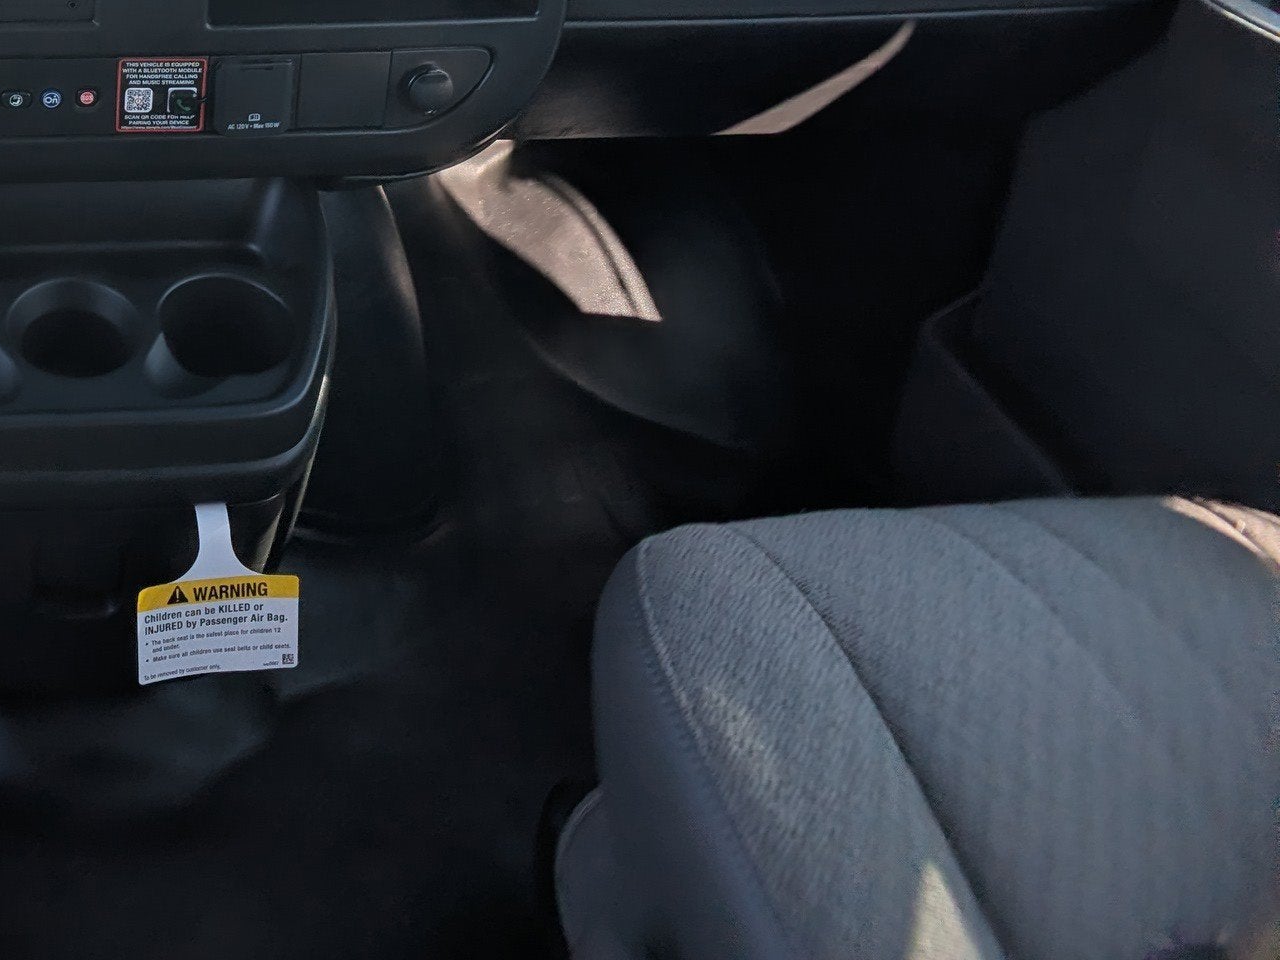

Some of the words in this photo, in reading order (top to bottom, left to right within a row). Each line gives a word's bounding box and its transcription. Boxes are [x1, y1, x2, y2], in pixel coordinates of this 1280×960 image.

[193, 582, 268, 602] WARNING
[144, 611, 182, 624] Children
[185, 609, 202, 618] can
[204, 606, 216, 614] be
[219, 603, 250, 613] KILLED
[145, 621, 183, 635] INJURED
[186, 620, 197, 629] by
[200, 616, 248, 626] Passenger
[251, 614, 264, 622] Air
[267, 613, 288, 623] Bag.
[190, 648, 212, 656] children
[158, 670, 178, 678] removed
